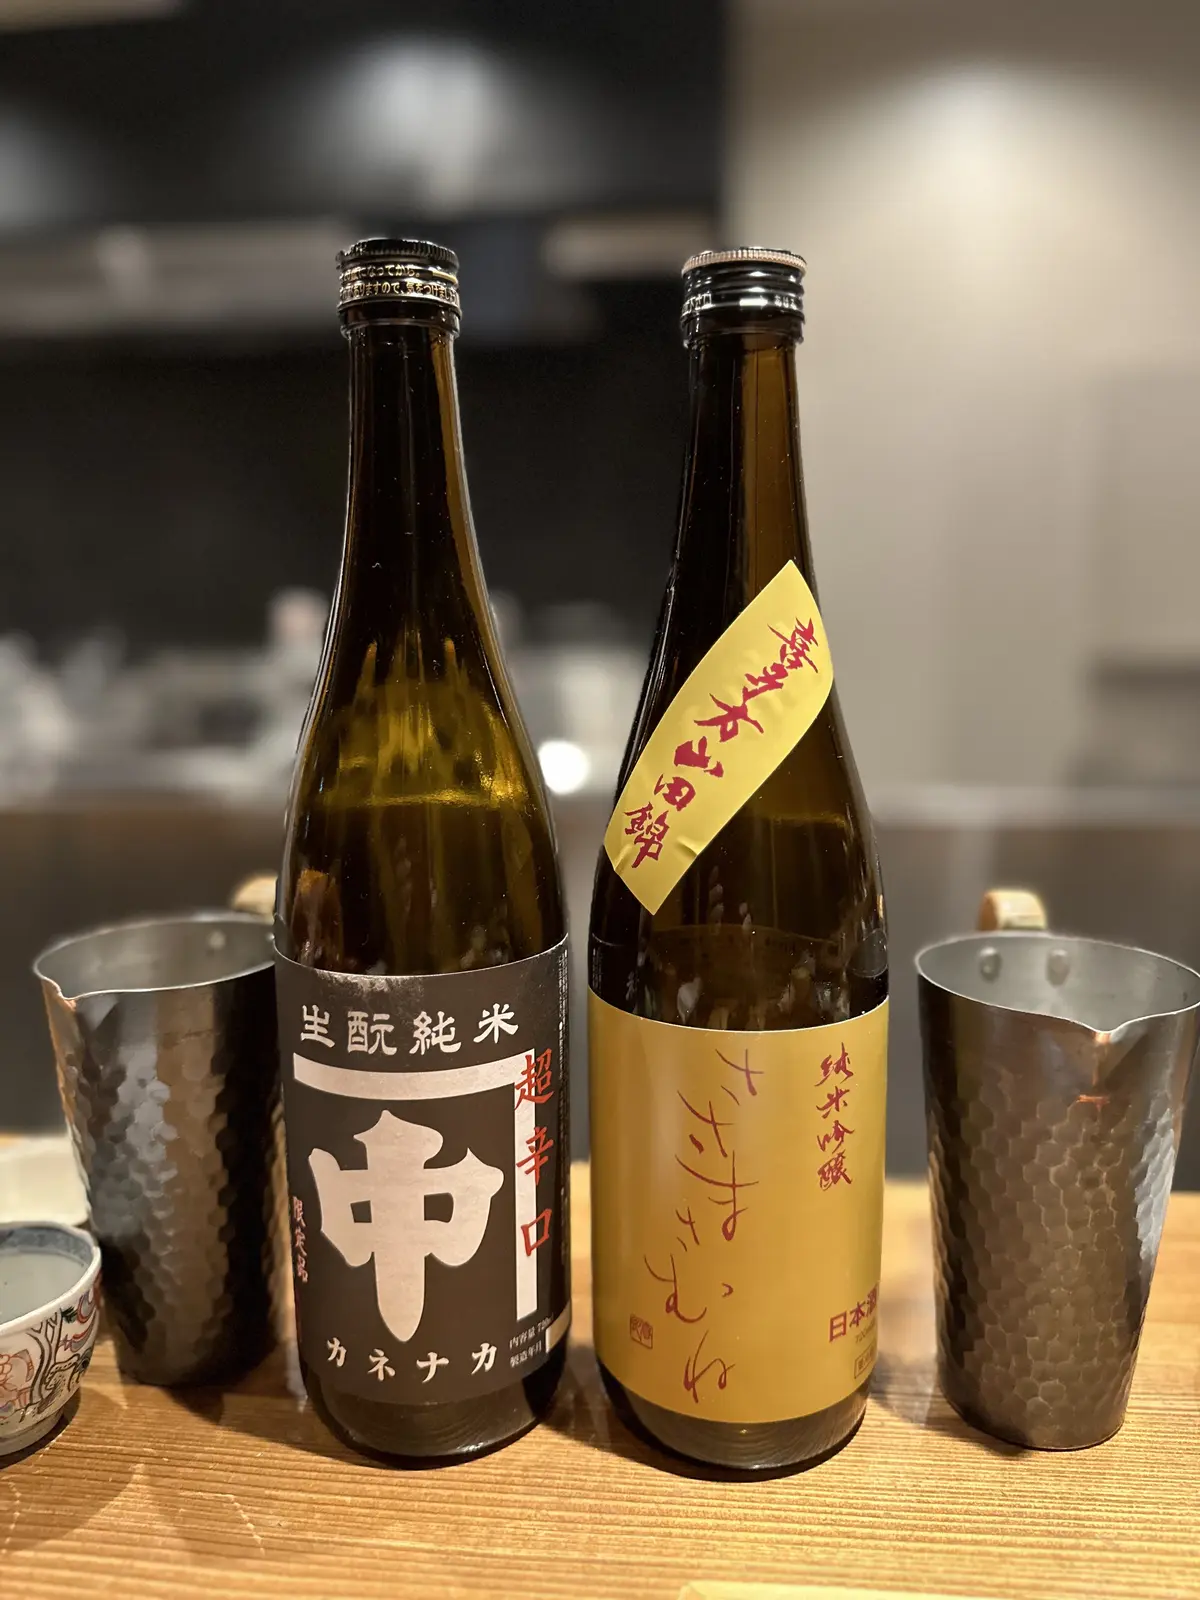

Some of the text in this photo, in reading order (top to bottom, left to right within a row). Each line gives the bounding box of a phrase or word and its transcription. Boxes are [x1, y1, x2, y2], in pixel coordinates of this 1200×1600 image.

[300, 1003, 519, 1056] 生酛純米
[514, 1048, 554, 1257] 超辛口
[814, 1042, 855, 1191] 純米吟醸
[326, 1337, 498, 1382] カネナカ
